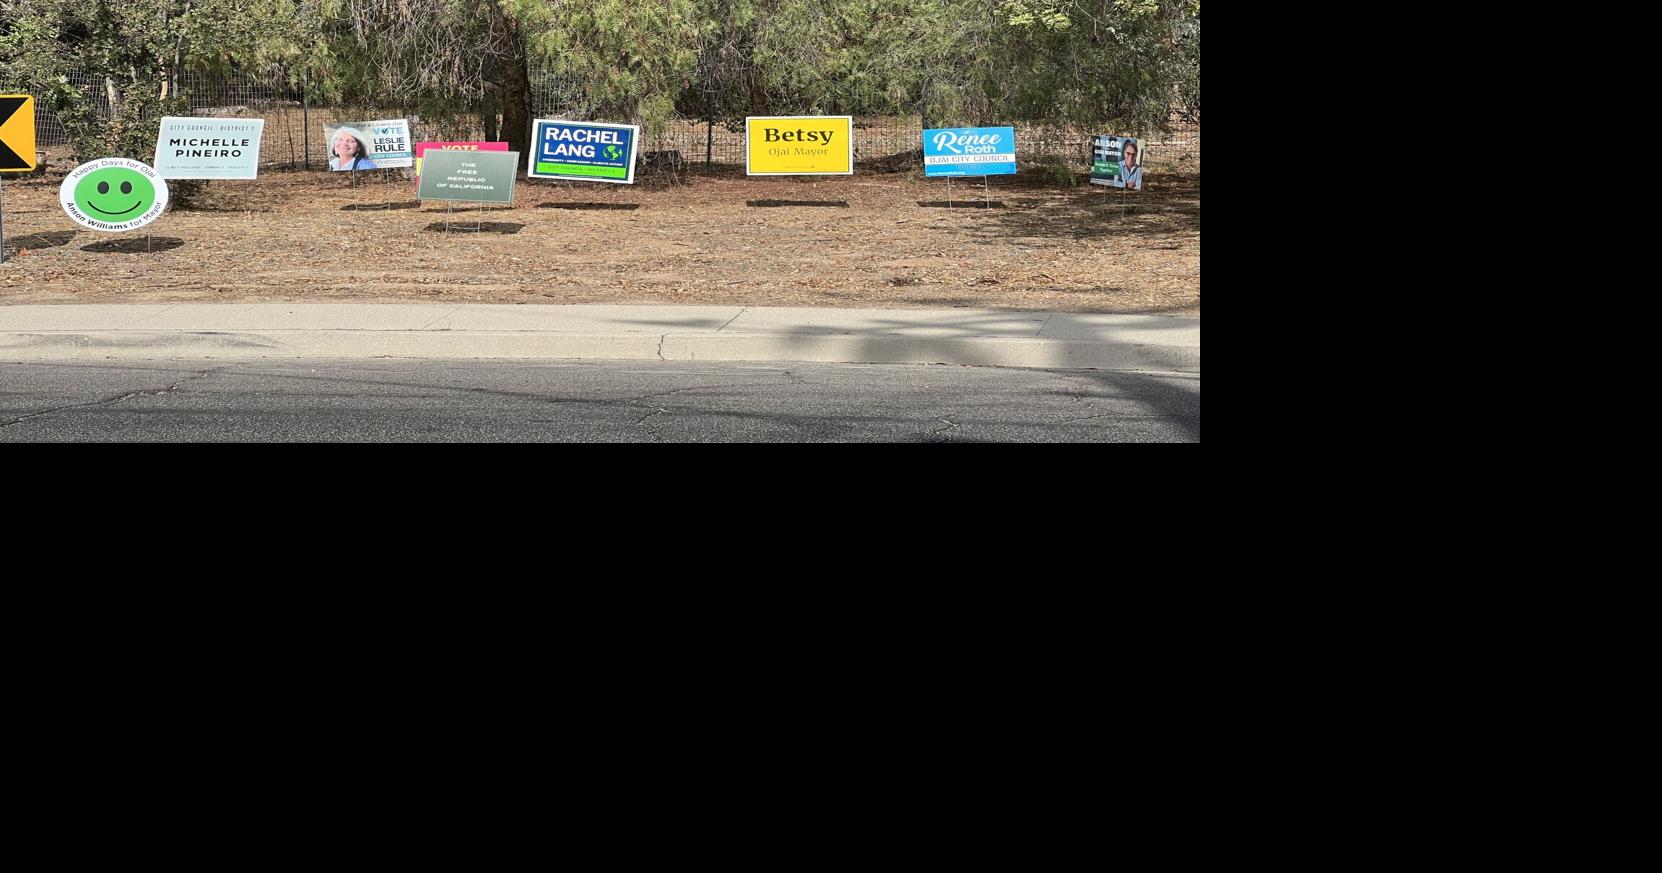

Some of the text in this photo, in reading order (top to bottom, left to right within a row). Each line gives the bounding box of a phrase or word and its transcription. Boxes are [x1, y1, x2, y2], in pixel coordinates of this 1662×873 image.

[373, 126, 404, 135] VOTE
[546, 128, 624, 144] RACHEL
[764, 128, 834, 146] Betsy
[169, 138, 250, 146] MICHELLE
[375, 144, 406, 152] RULE
[544, 142, 596, 158] LANG
[768, 148, 828, 157] Ojai Mayor
[964, 145, 996, 154] Roth
[176, 150, 242, 158] PINEIRO
[72, 162, 98, 179] Happy
[126, 160, 139, 169] for
[140, 166, 158, 178] Ojai
[66, 202, 161, 230] Anson Williams for Mayor
